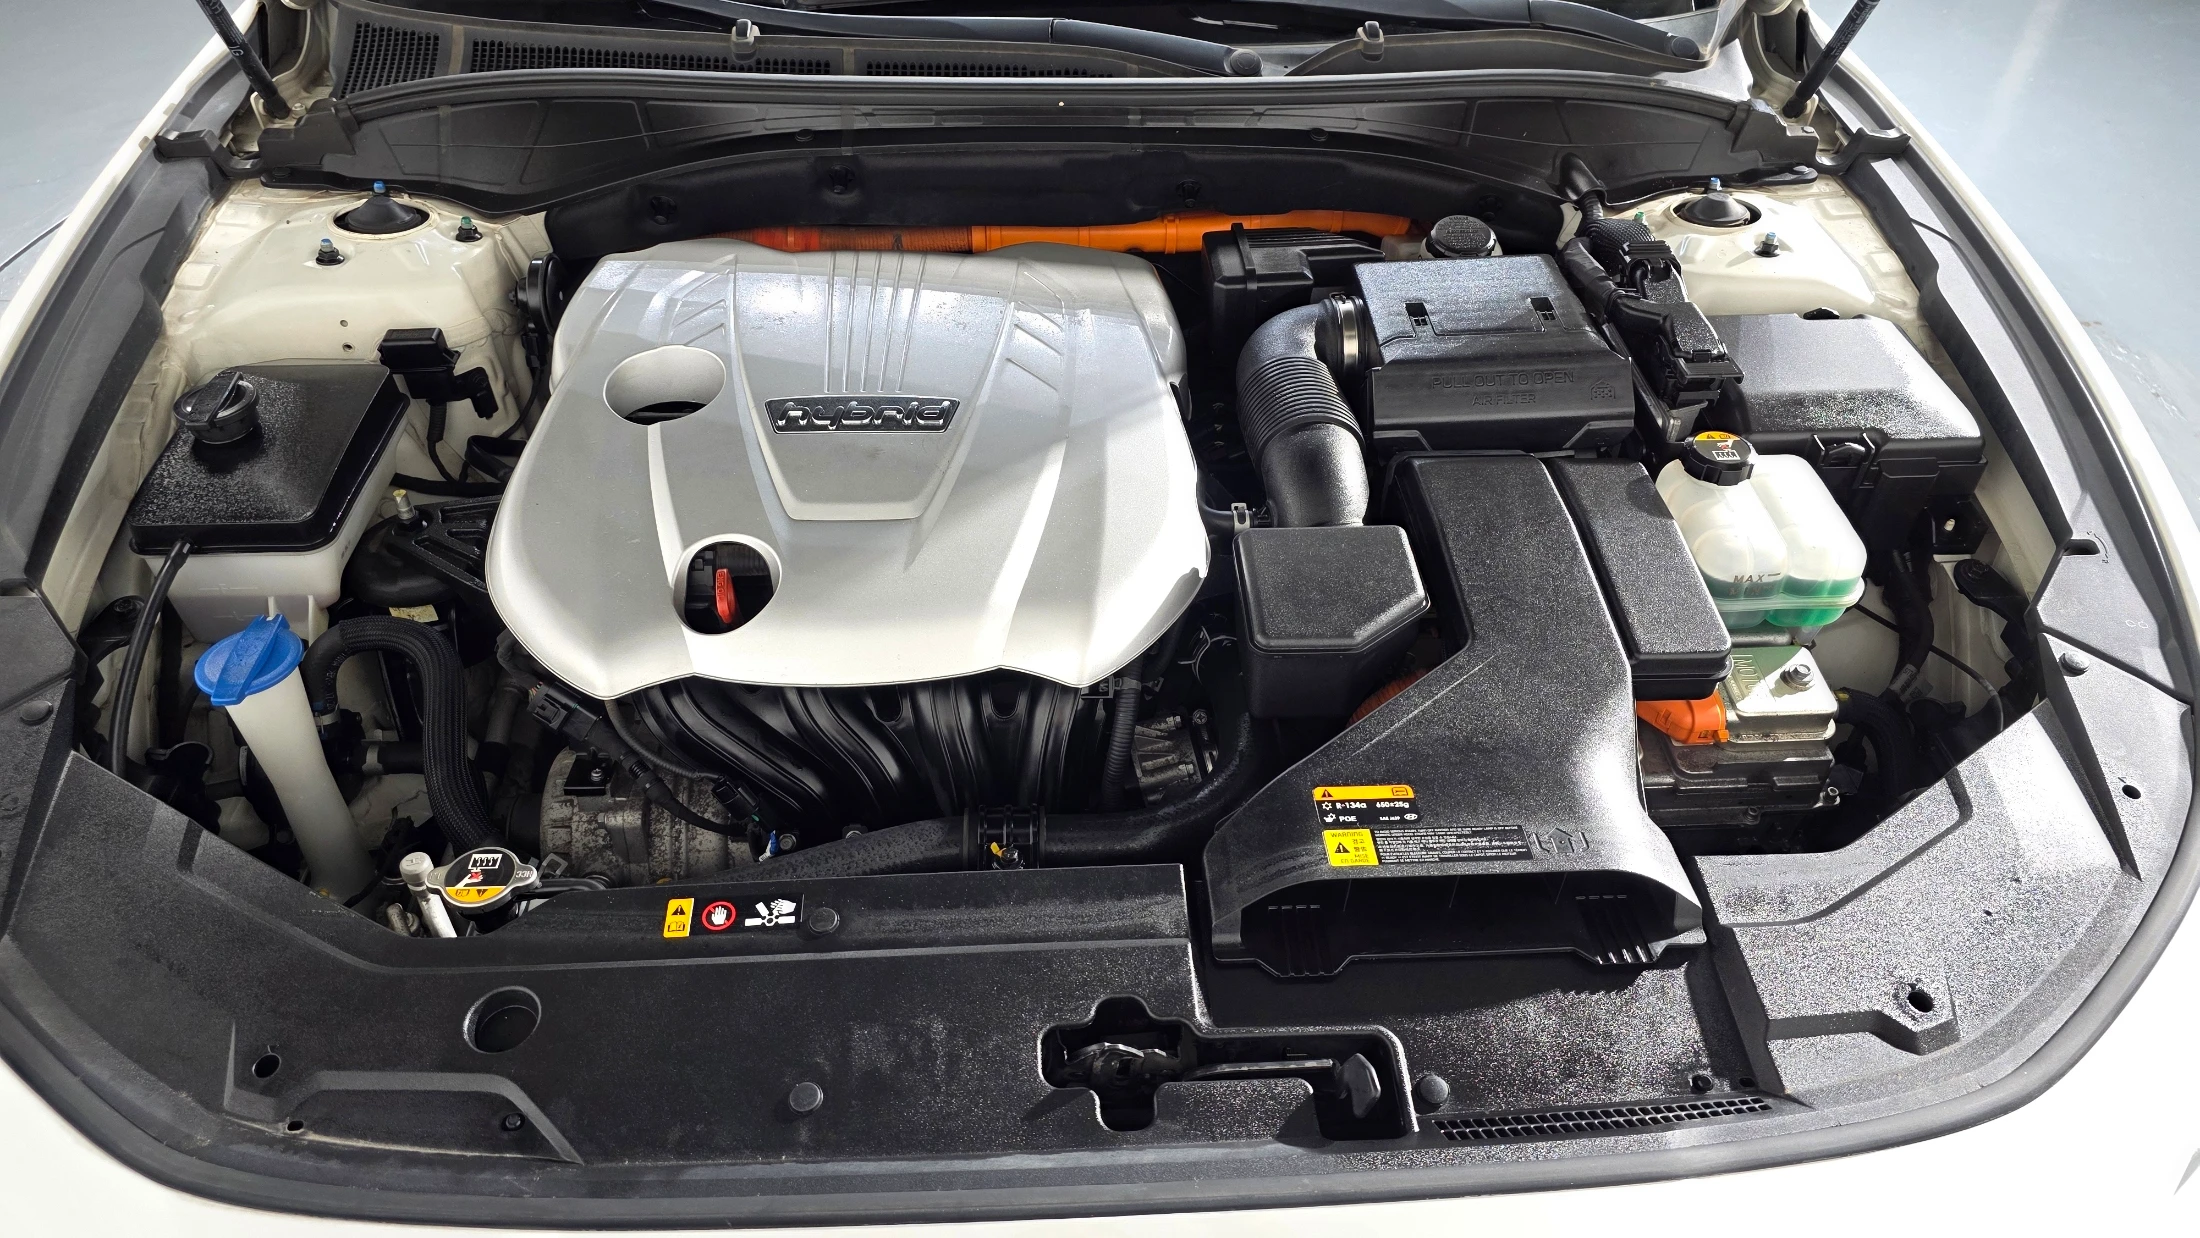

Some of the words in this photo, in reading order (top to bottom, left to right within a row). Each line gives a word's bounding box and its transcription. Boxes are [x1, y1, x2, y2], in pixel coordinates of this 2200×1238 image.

[1432, 375, 1471, 389] PULL
[1474, 373, 1504, 387] OUT
[1508, 372, 1530, 386] TO
[1534, 370, 1575, 385] OPEN
[1472, 395, 1494, 407] AIR
[1496, 392, 1537, 406] FILTER
[777, 401, 951, 430] hybrid
[717, 571, 725, 586] ENG
[1733, 574, 1765, 583] MAX
